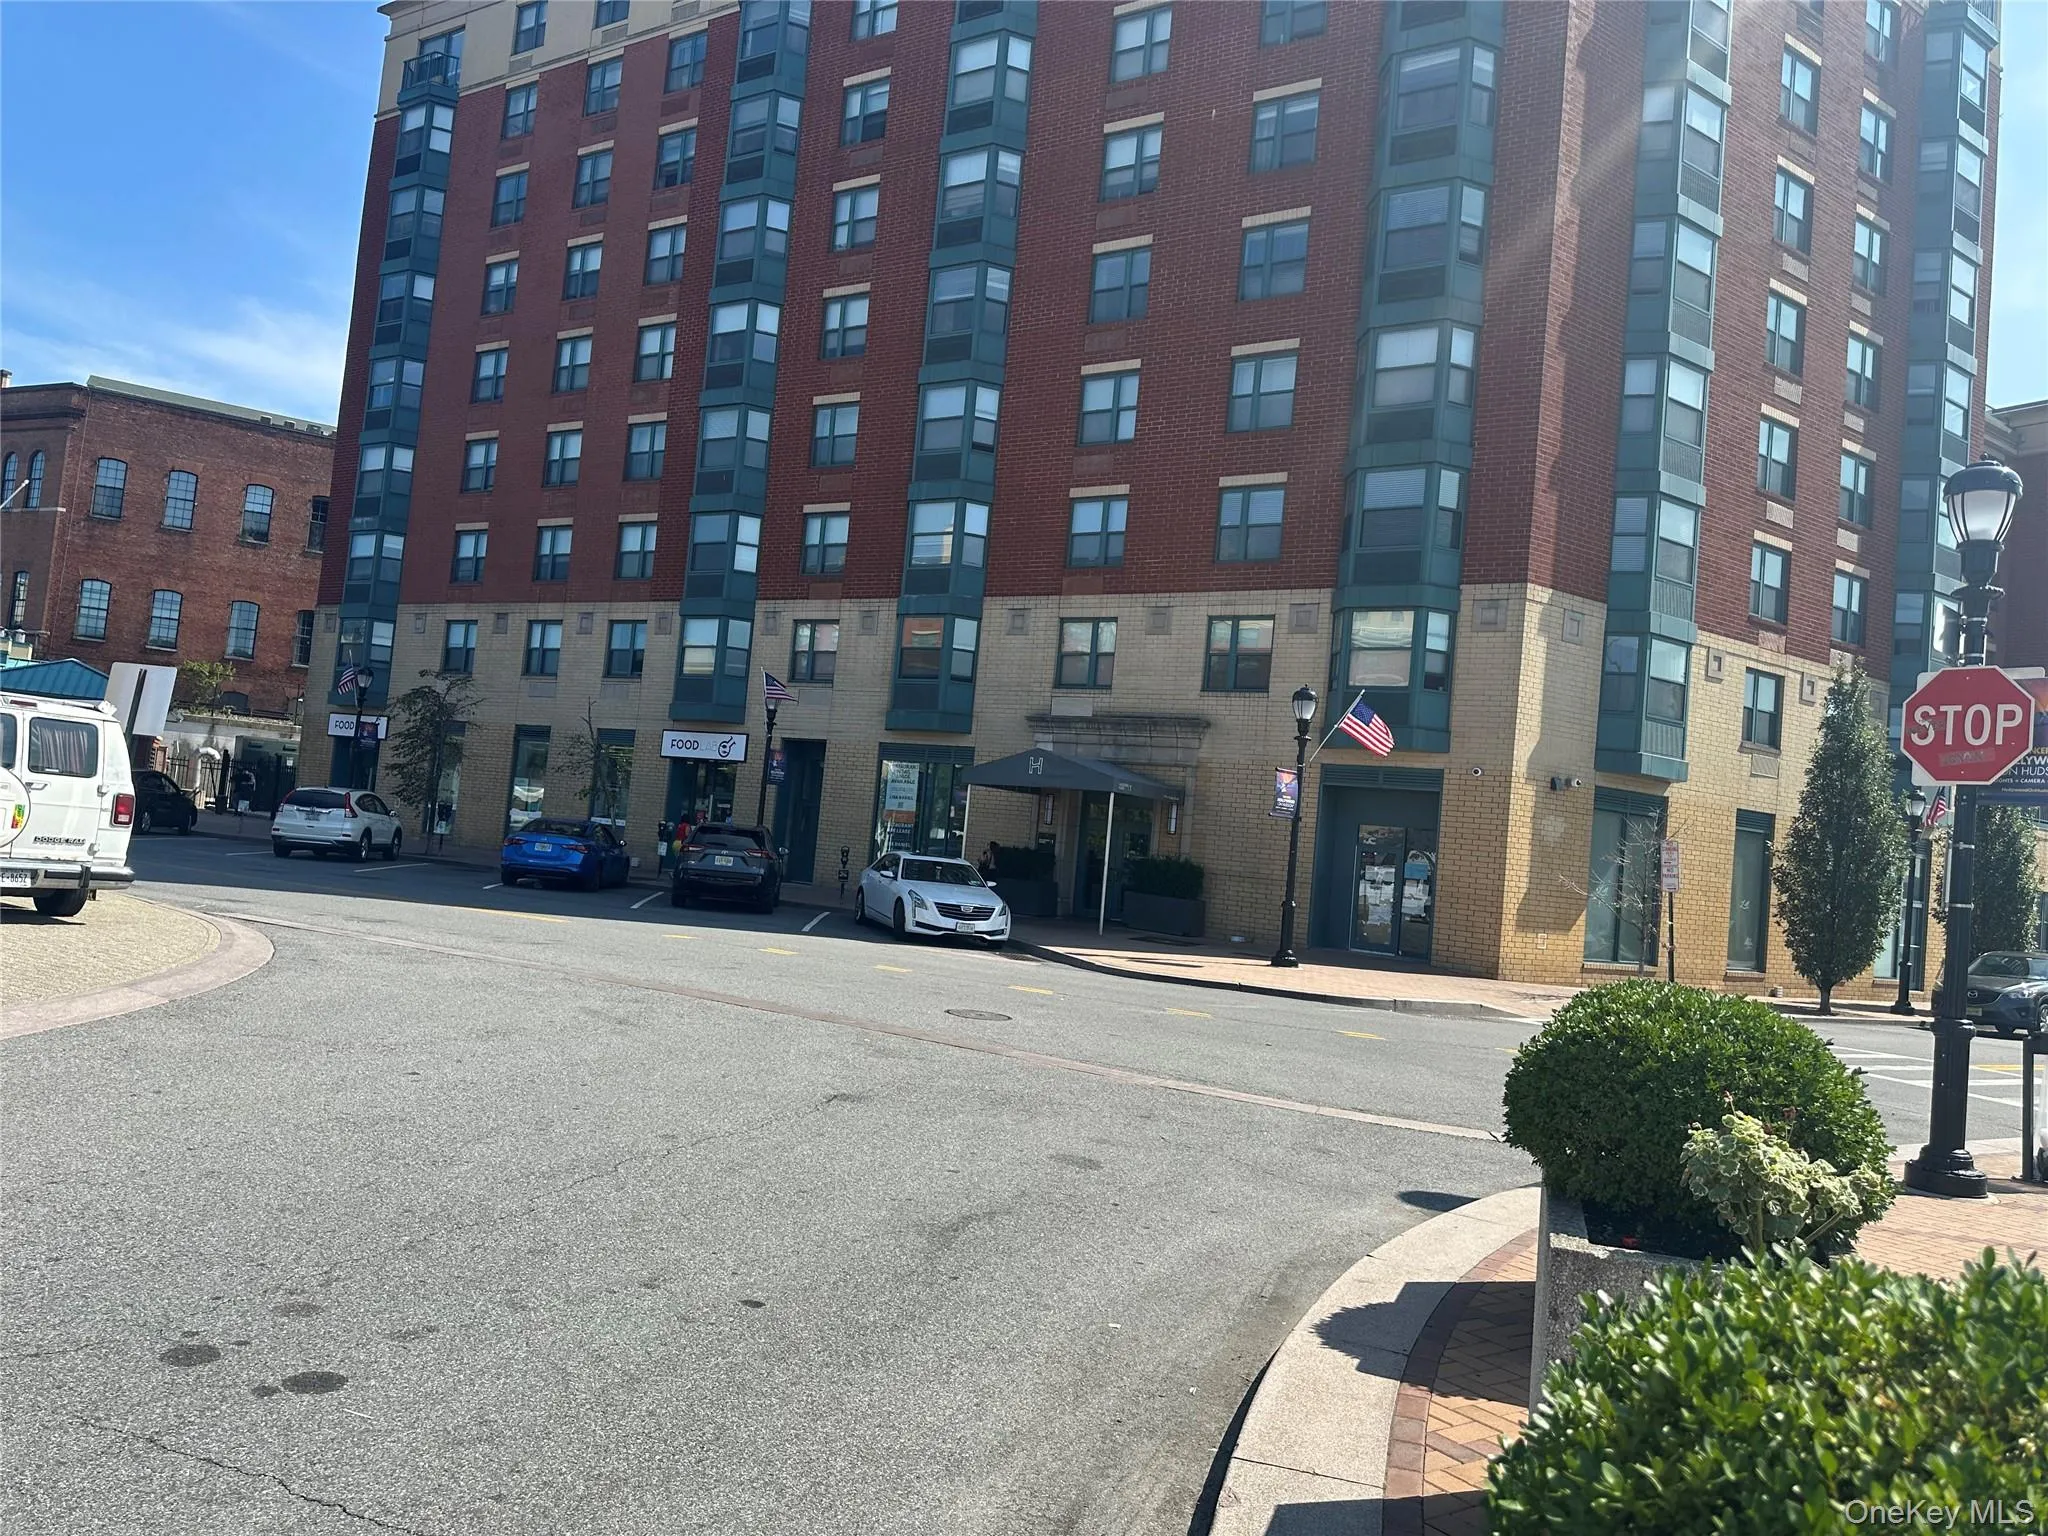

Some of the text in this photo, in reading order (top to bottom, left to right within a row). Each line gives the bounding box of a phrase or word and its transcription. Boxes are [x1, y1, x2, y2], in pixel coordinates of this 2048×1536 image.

[334, 720, 355, 730] FOOD
[1911, 703, 2023, 746] STOP
[670, 738, 700, 751] FOOD
[1028, 756, 1043, 775] H
[2017, 755, 2048, 766] LYW
